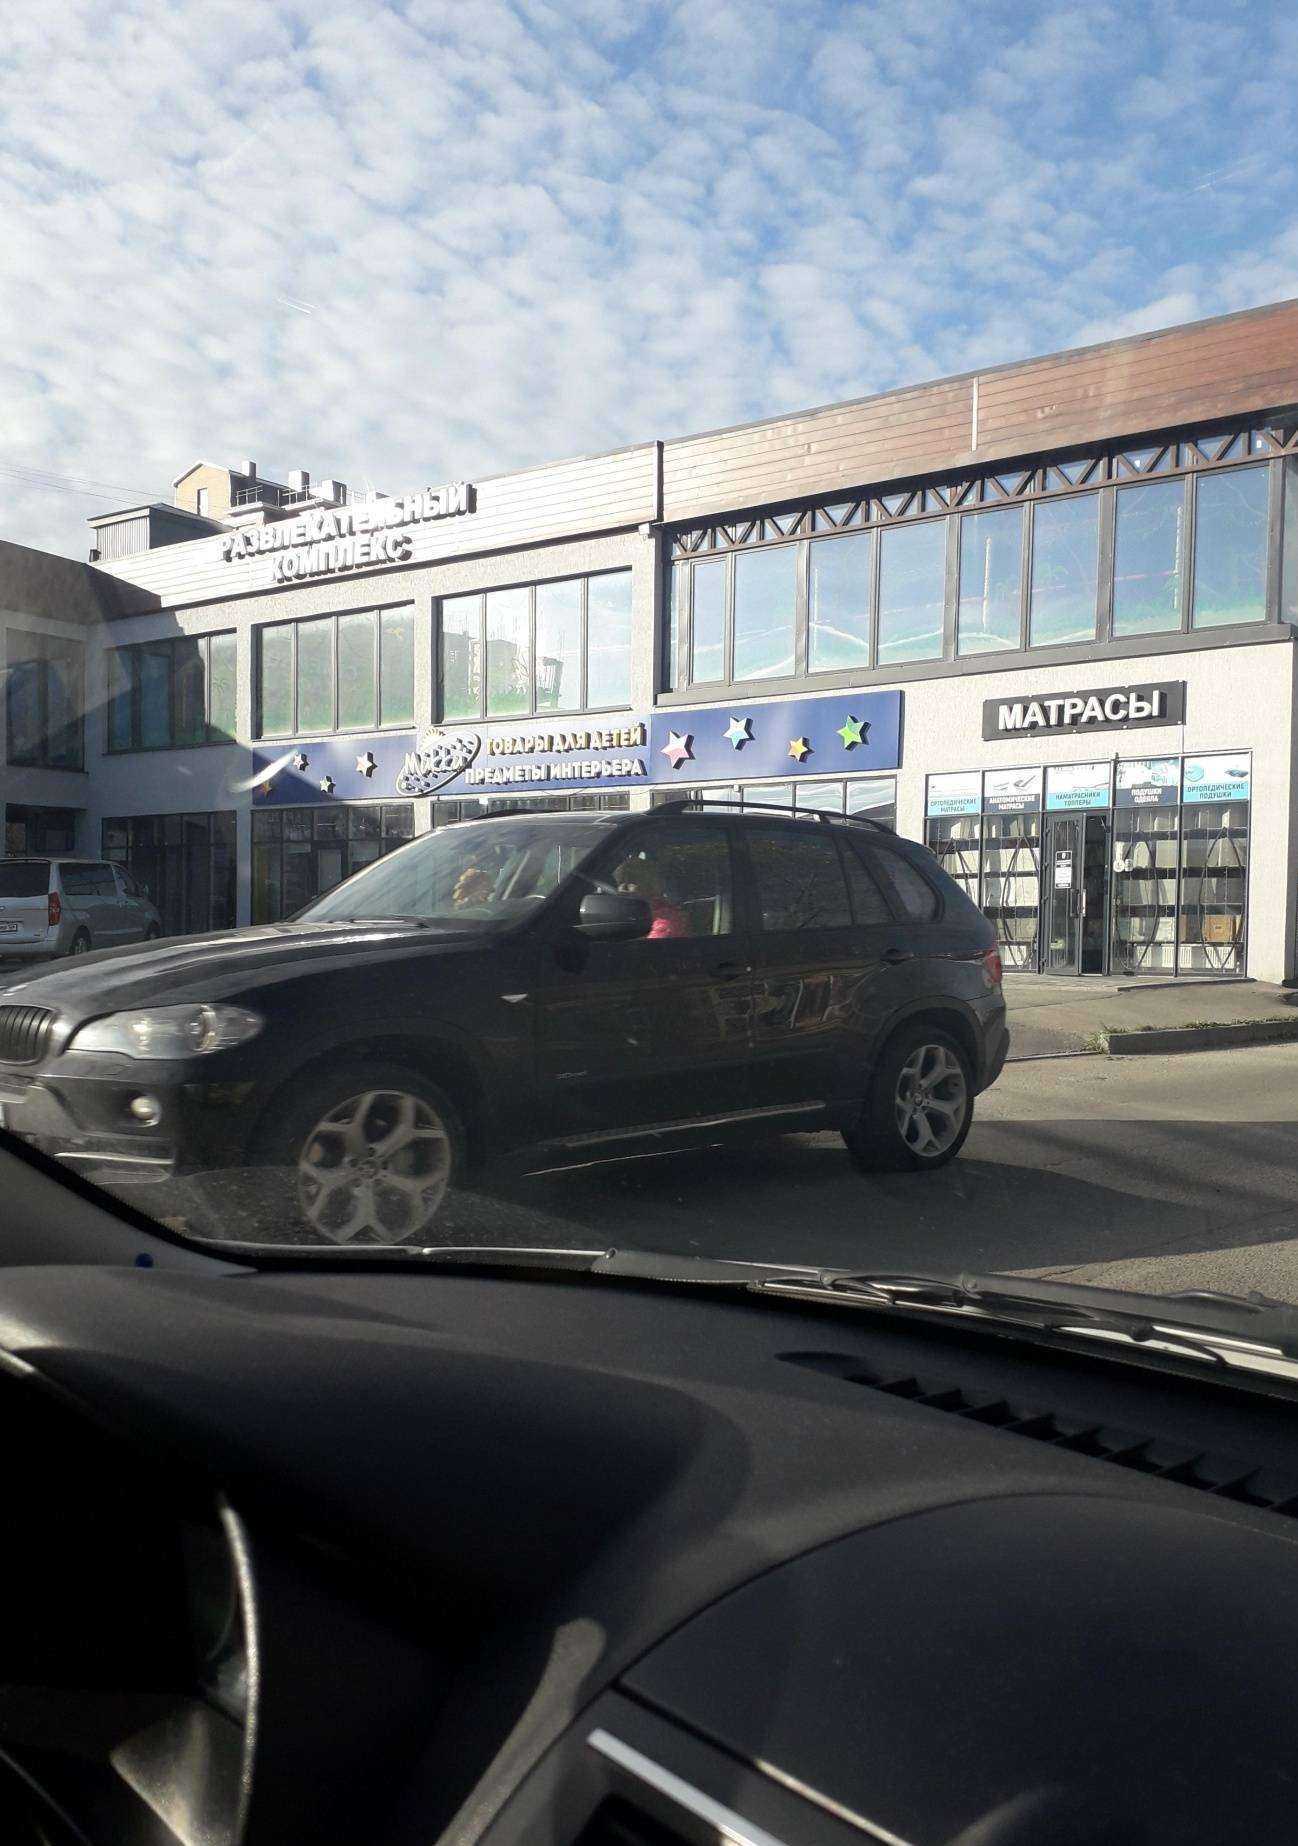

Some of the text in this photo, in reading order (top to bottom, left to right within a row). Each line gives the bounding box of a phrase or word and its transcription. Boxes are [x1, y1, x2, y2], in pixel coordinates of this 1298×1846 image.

[216, 481, 476, 561] РАЗВЛЕКАТЕЛЬНЫЙ
[272, 533, 412, 582] КОМПЛЕКС
[998, 689, 1164, 731] МАТРАСЫ
[488, 722, 646, 756] ТОВАРЫ ДЛЯ ДЕТЕЙ
[465, 758, 647, 785] ПРЕДМЕТЫ ИНТЕРЬЕРА
[1055, 791, 1101, 800] НАМАТРАСНИКИ
[1187, 782, 1245, 793] ОРТОПЕДИЧЕСКИЕ
[1199, 791, 1232, 800] ПОДУШКИ
[930, 798, 977, 807] ОРТОПЕДИЧЕСКИЕ
[940, 805, 966, 813] МАТРАСЫ
